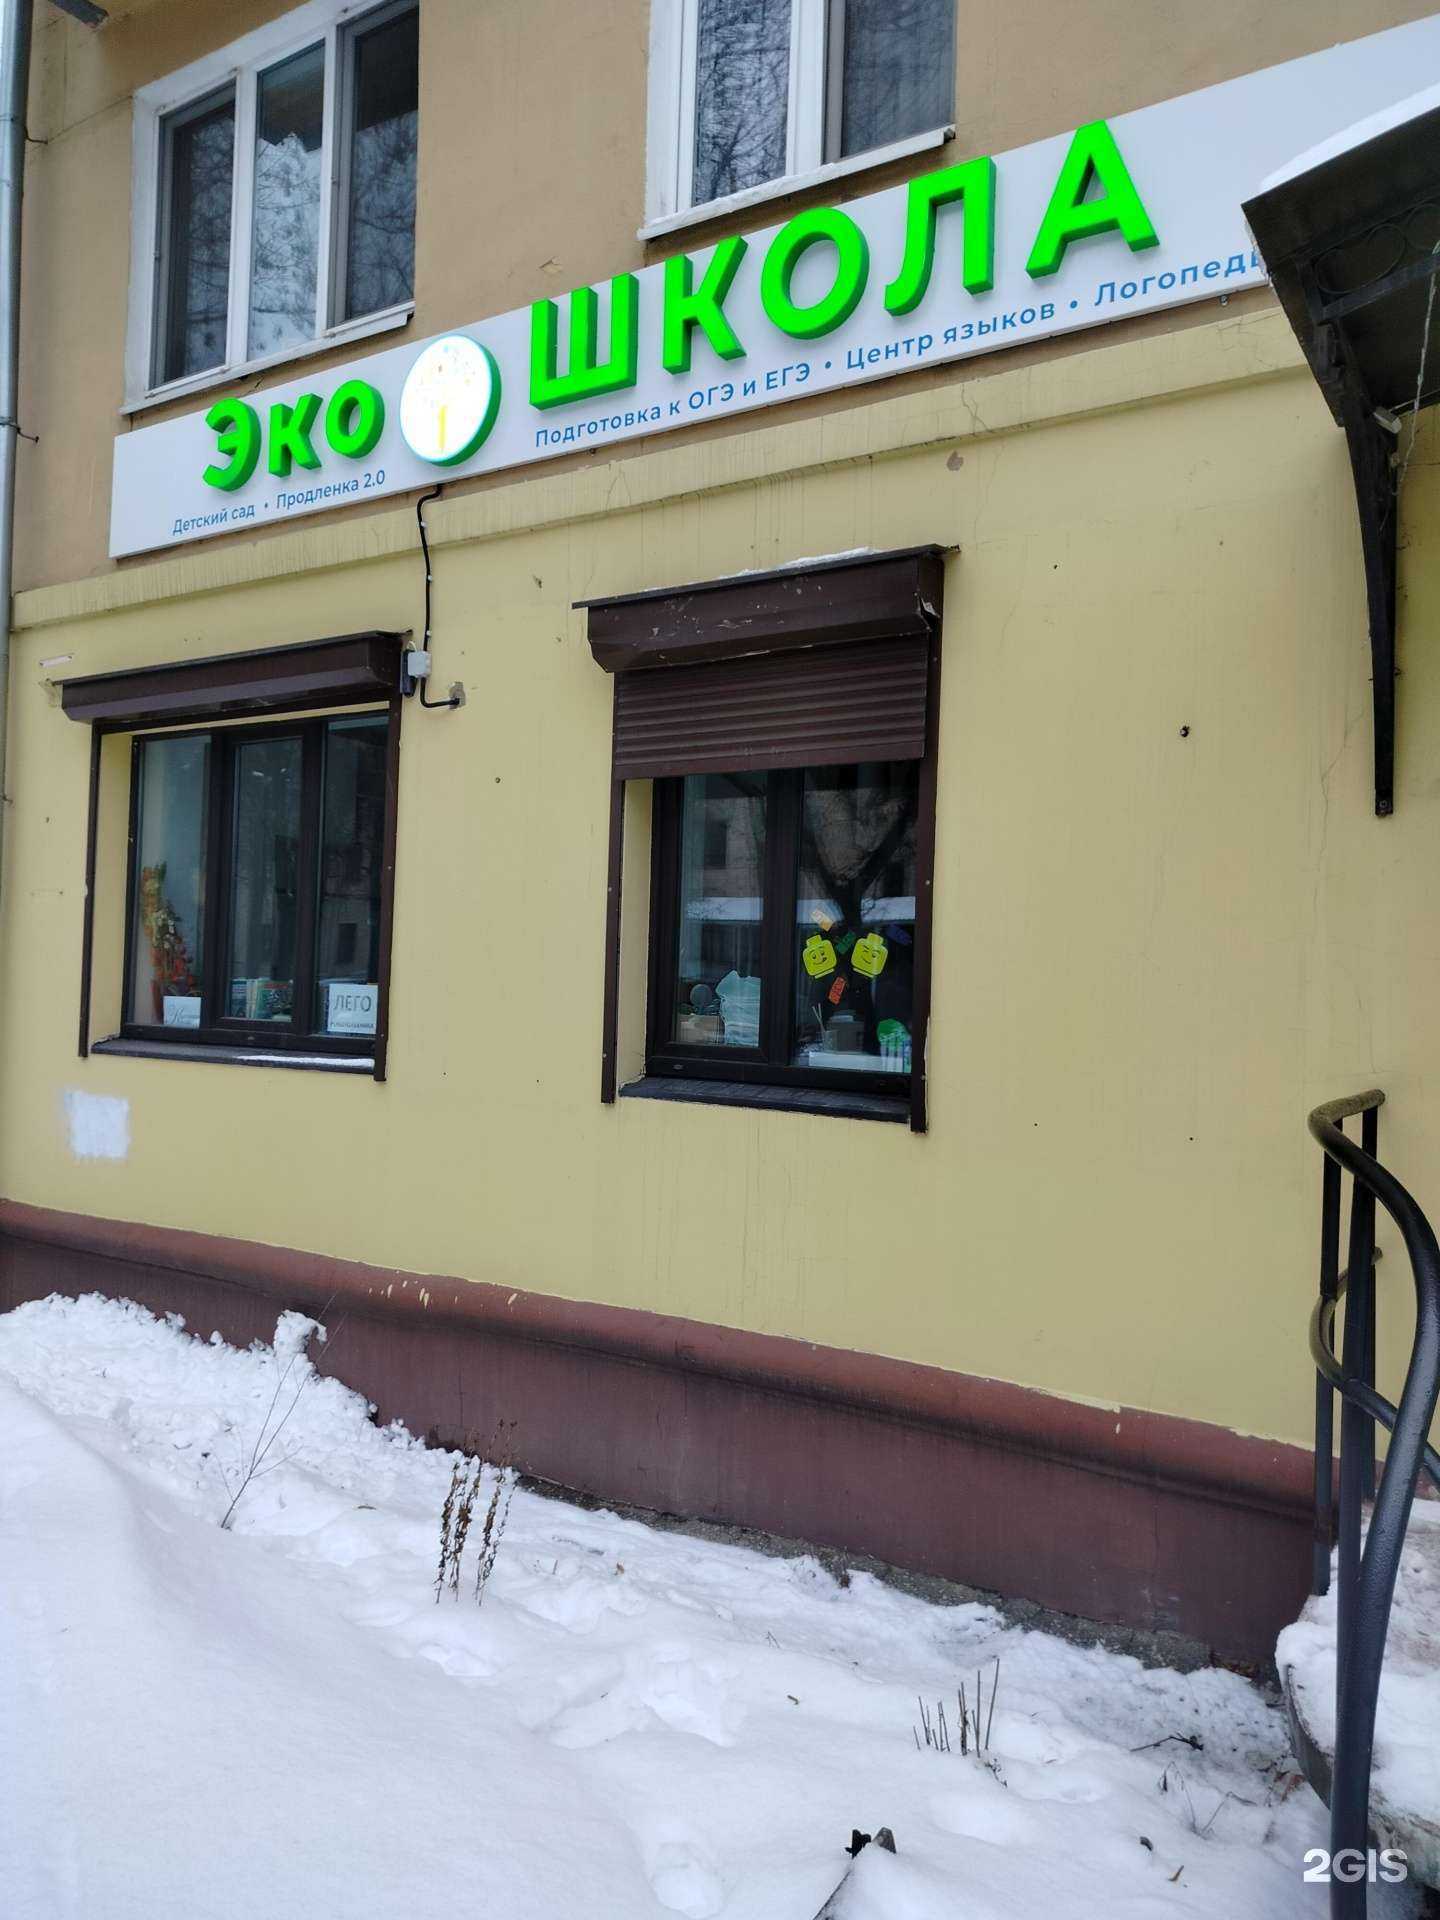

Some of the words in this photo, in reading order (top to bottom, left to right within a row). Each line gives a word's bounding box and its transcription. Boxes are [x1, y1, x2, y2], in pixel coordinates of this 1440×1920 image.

[529, 119, 1160, 411] ШКОЛА
[535, 406, 661, 447] Подготовка
[669, 400, 681, 416] к
[688, 384, 734, 410] ОГЭ
[742, 379, 756, 396] и
[765, 363, 811, 391] ЕГЭ
[847, 334, 933, 369] Центр
[943, 303, 1055, 343] языков
[172, 508, 228, 535] Детский
[231, 505, 255, 523] сад
[276, 480, 359, 509] Продленка
[363, 470, 386, 489] 2.0
[333, 994, 372, 1012] ЛЕГО
